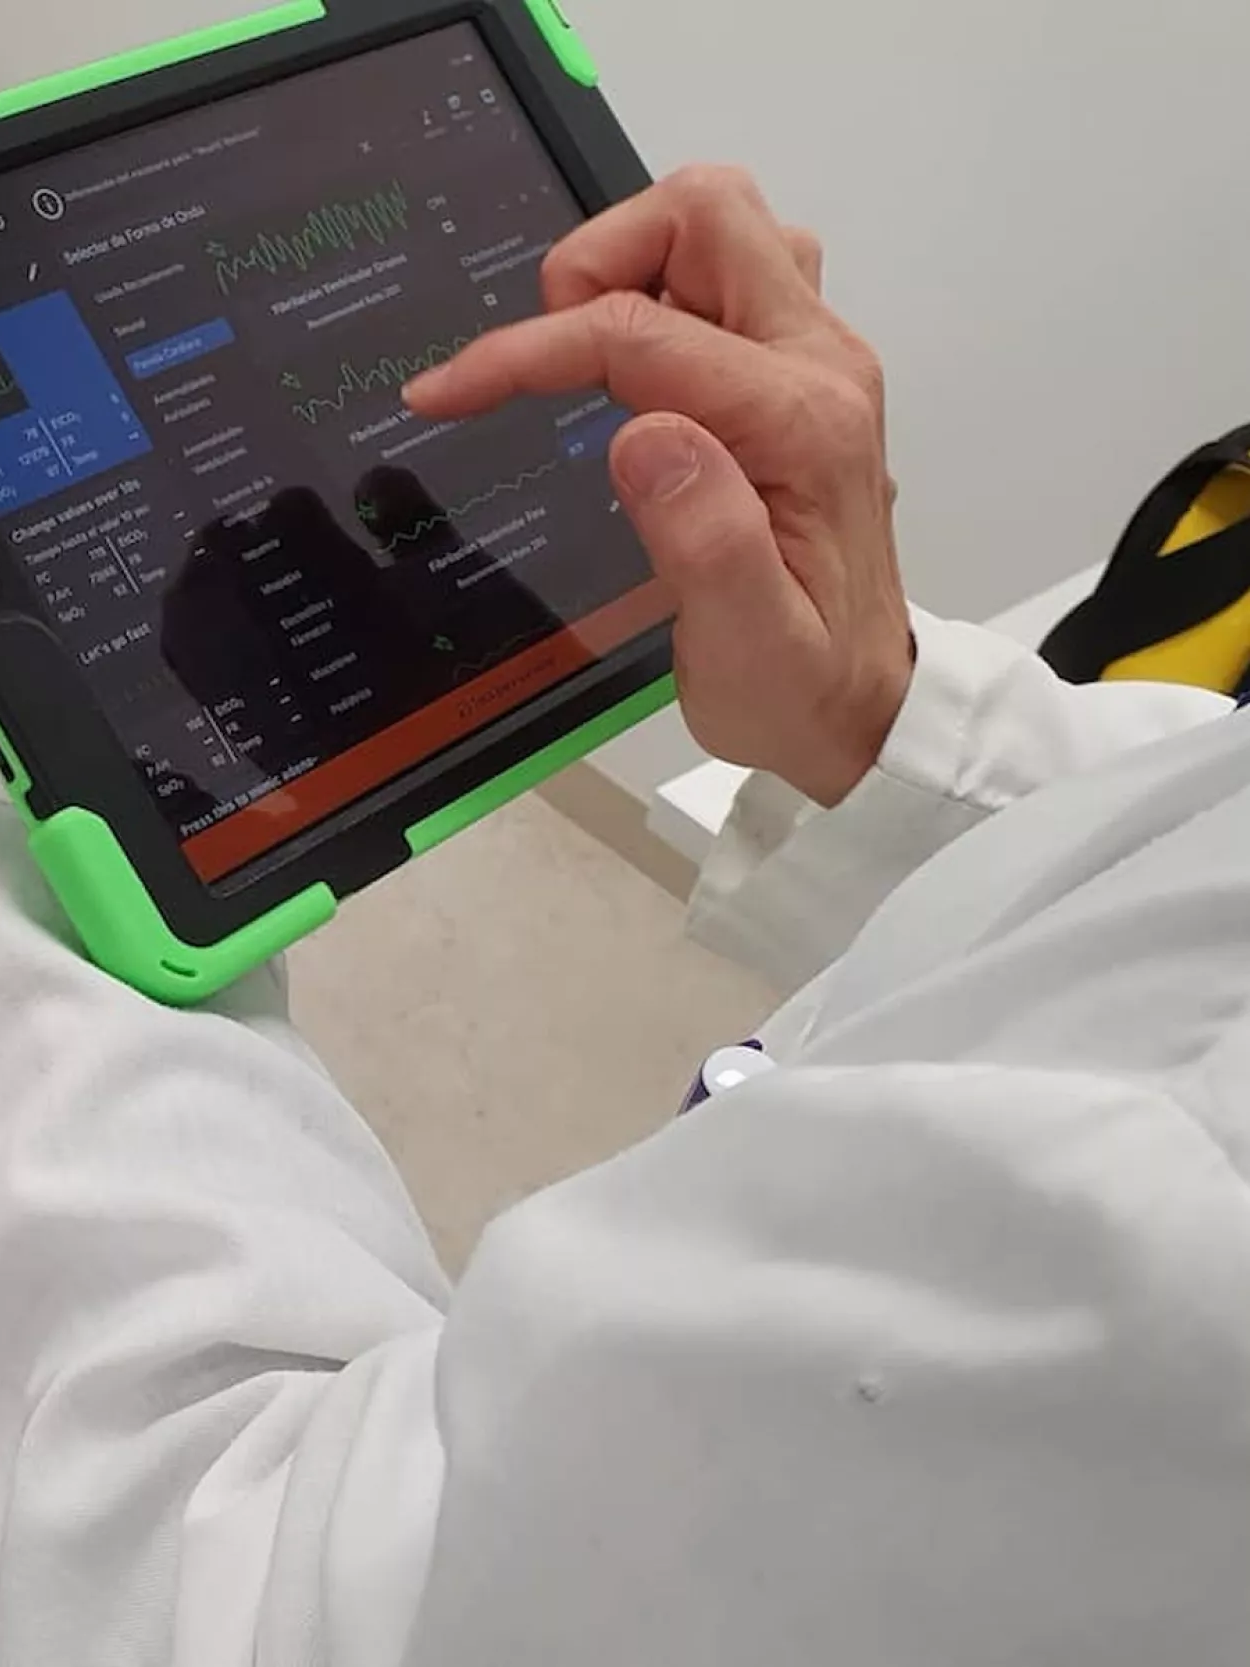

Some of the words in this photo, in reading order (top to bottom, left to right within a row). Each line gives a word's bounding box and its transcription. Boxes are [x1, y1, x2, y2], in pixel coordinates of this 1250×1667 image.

[62, 241, 109, 265] Selector
[110, 234, 126, 248] de
[125, 222, 161, 242] Forma
[160, 214, 176, 229] de
[175, 204, 206, 225] Onda
[11, 516, 57, 544] Change
[56, 501, 95, 523] values
[95, 488, 119, 506] over
[78, 643, 112, 665] Let's
[110, 634, 128, 651] go
[126, 622, 151, 641] fast
[179, 814, 214, 836] Press
[212, 800, 236, 819] this
[234, 794, 250, 808] to
